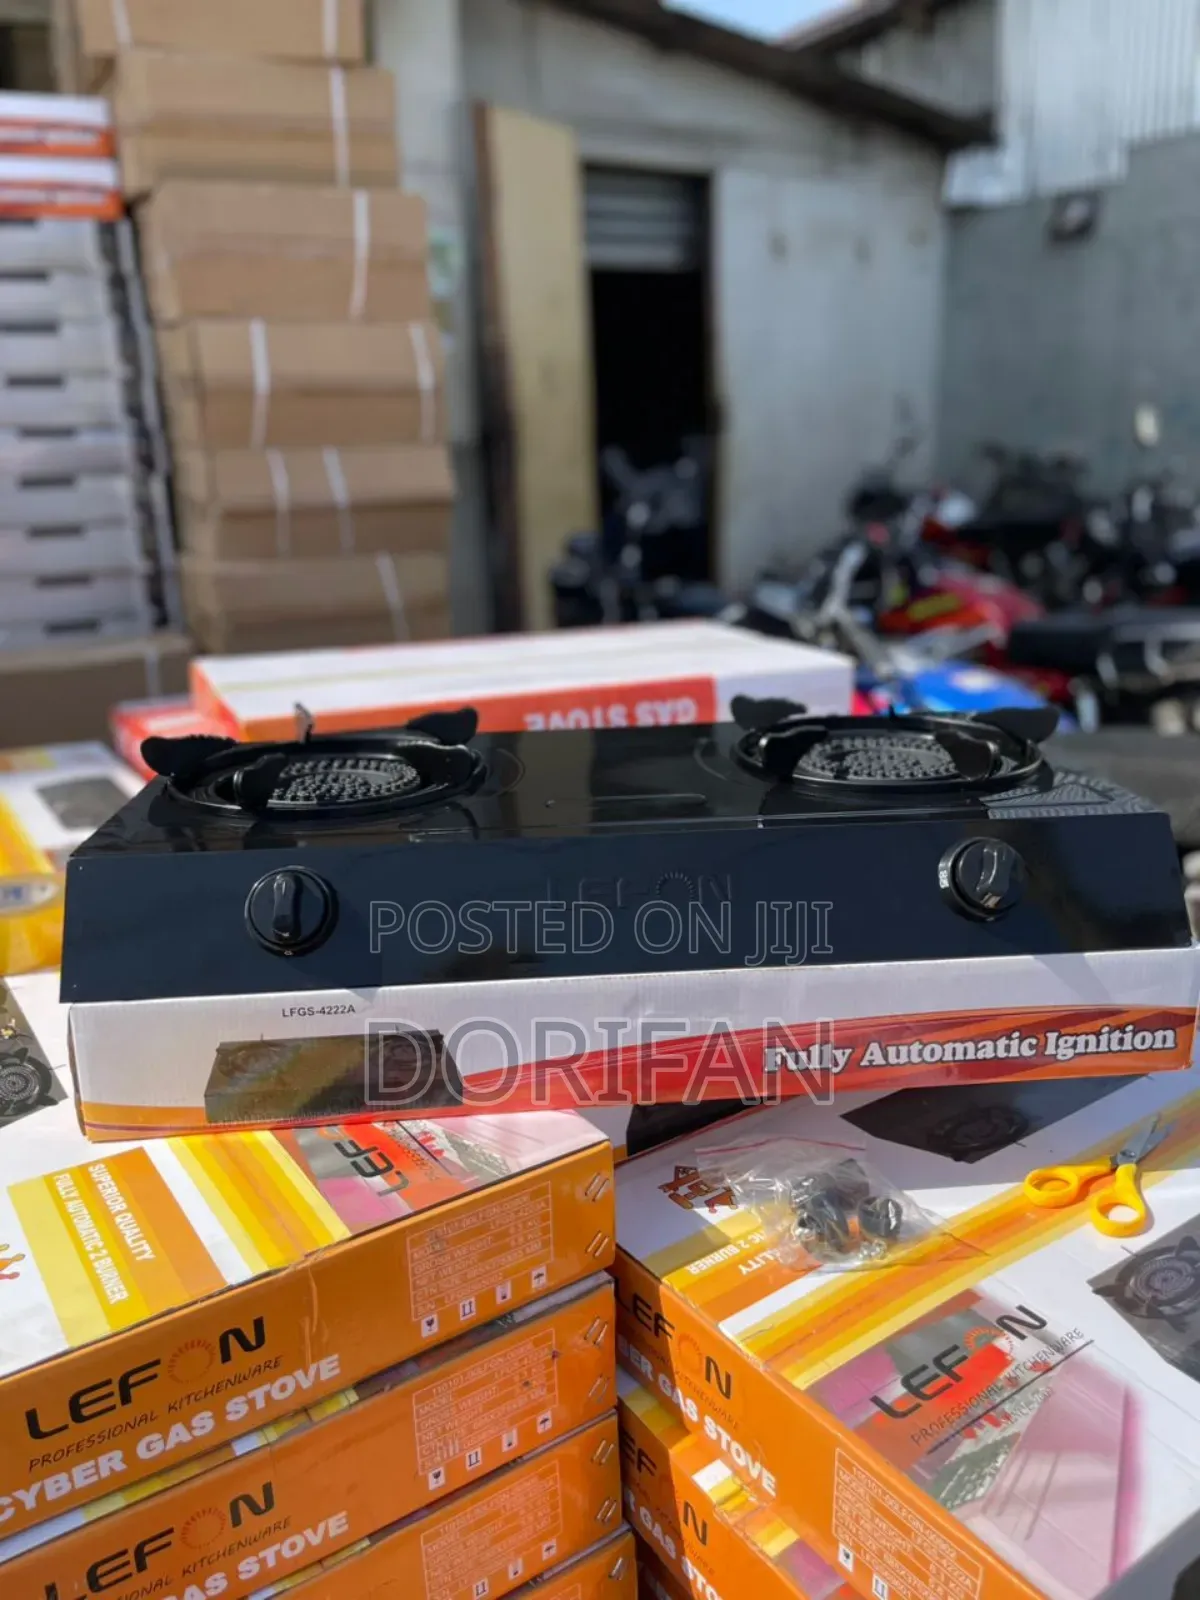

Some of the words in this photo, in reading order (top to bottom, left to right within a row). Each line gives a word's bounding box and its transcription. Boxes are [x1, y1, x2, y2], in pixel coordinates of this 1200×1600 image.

[635, 696, 698, 727] GAS
[282, 1004, 356, 1018] LFGS-4222A
[764, 1043, 851, 1073] Fully
[859, 1031, 1039, 1067] Automatic
[1043, 1024, 1176, 1061] Ignition
[53, 1172, 80, 1200] FULLY
[88, 1163, 128, 1215] SUPERIOR
[114, 1212, 156, 1261] QUALITY
[64, 1199, 104, 1251] AUTOMATIC
[88, 1249, 108, 1261] 2
[92, 1257, 129, 1305] BURNER
[686, 1243, 741, 1275] BURNER
[25, 1316, 266, 1440] LEFON
[870, 1304, 1048, 1419] LEFON
[910, 1382, 1005, 1448] PROFESSIONAL
[1006, 1327, 1085, 1383] KITCHENWARE
[0, 1450, 128, 1523] CYBER
[136, 1410, 215, 1460] GAS
[225, 1353, 342, 1422] STOVE
[29, 1412, 160, 1474] PROFESSIONAL
[167, 1354, 284, 1415] KITCHENWARE
[658, 1373, 699, 1423] GAS
[703, 1414, 777, 1498] STOVE
[163, 1571, 228, 1600] AS
[238, 1511, 349, 1580] STOVE
[181, 1516, 291, 1578] KITCHENWARE
